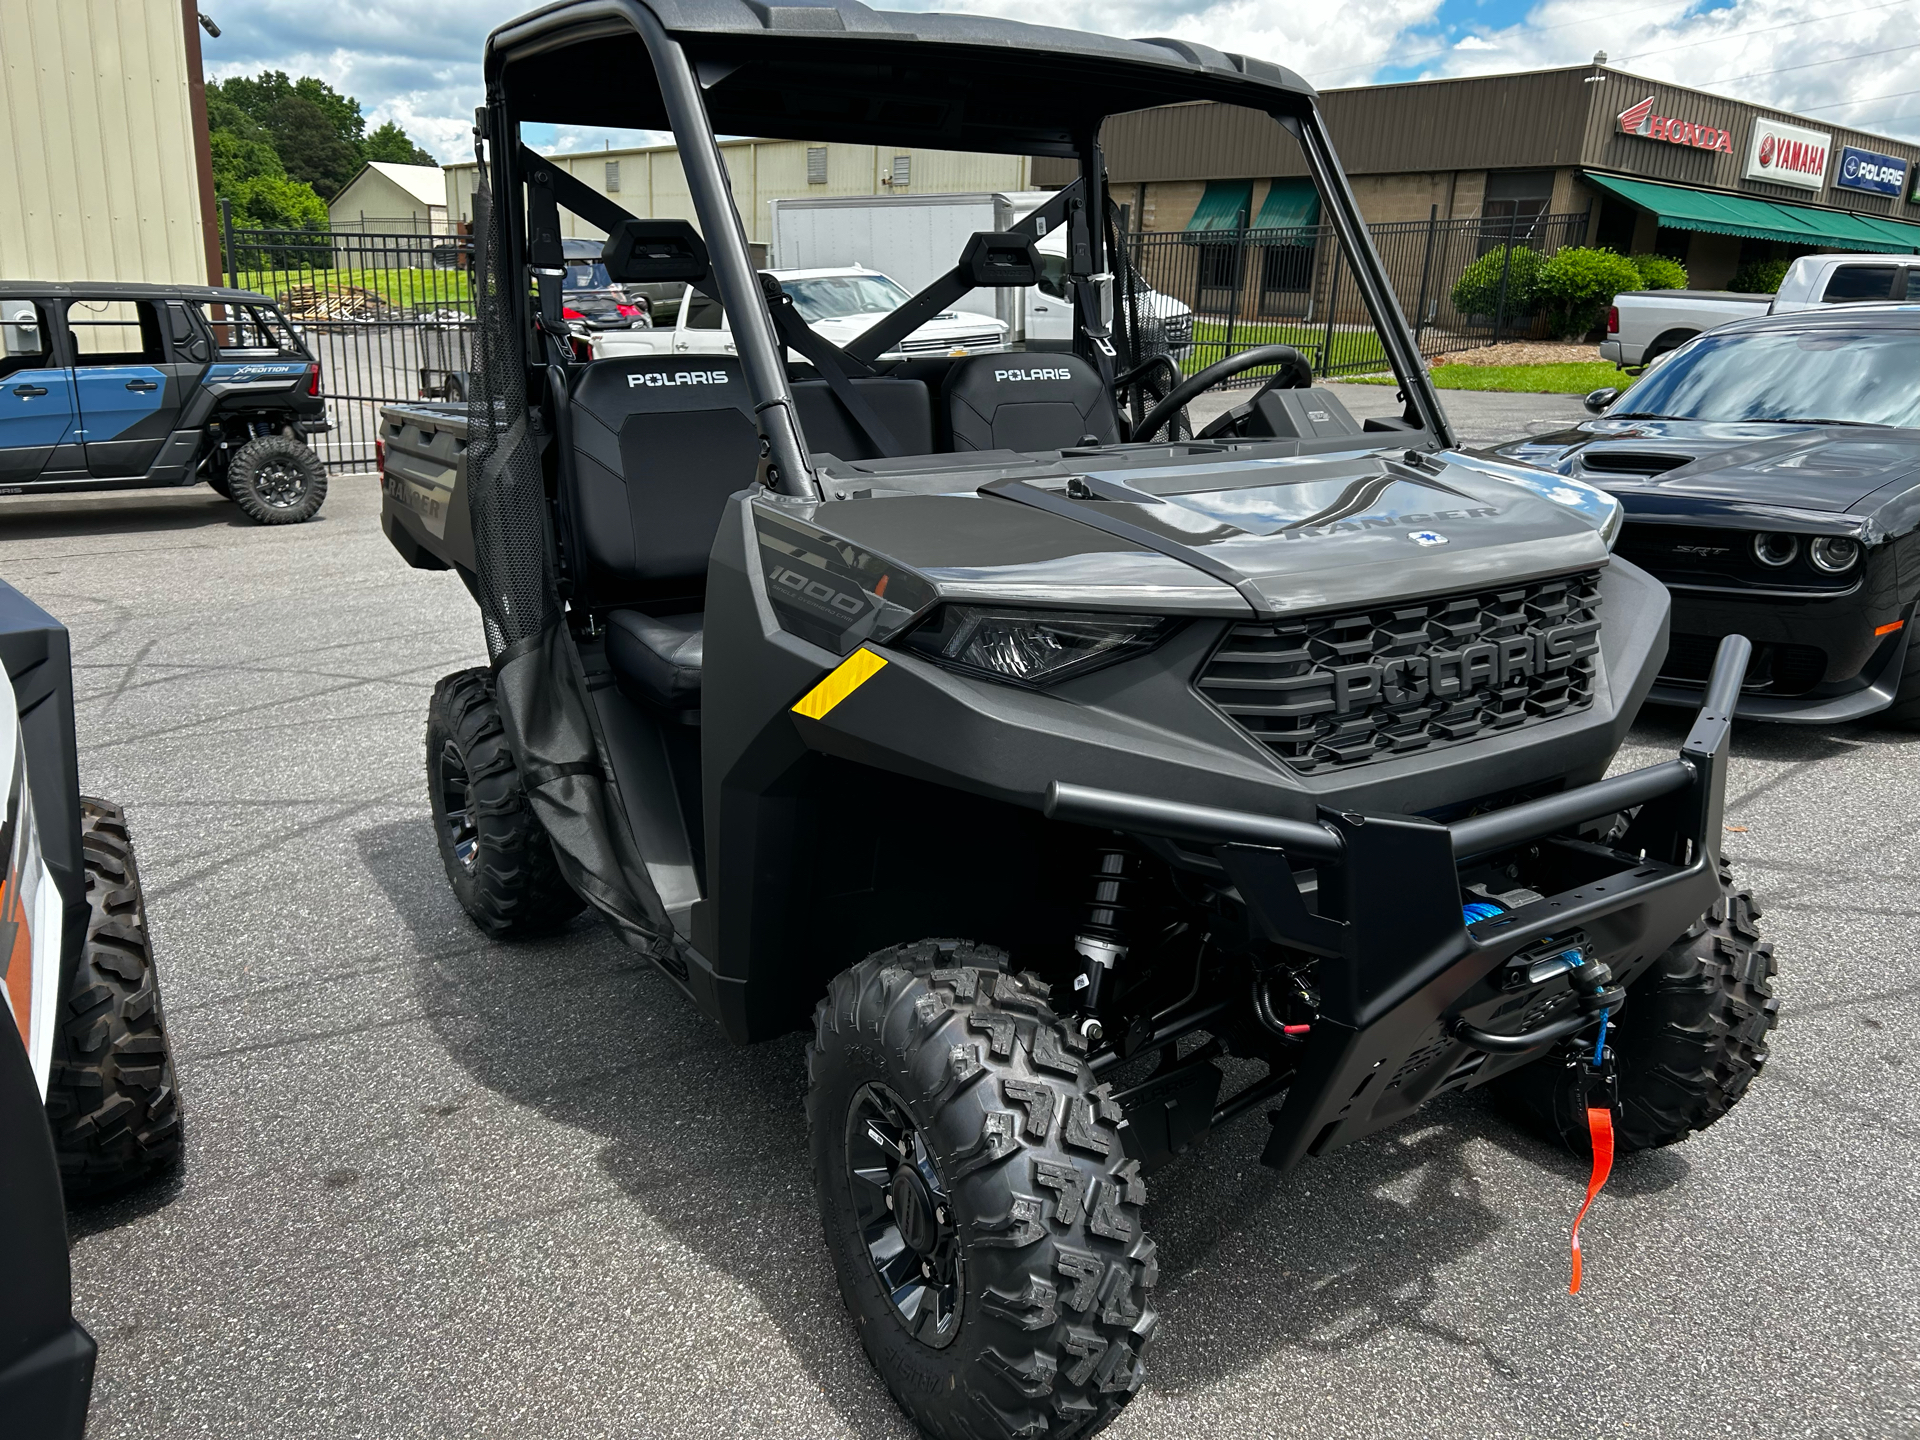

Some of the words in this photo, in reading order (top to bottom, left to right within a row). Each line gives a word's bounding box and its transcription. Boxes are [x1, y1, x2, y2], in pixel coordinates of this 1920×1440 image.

[1647, 114, 1734, 154] HONDA
[1775, 137, 1825, 176] YAMAHA
[1857, 161, 1905, 186] POLARIS
[233, 364, 289, 376] XPEDITION
[627, 370, 729, 388] POLARIS
[994, 368, 1071, 382] POLARIS
[387, 477, 440, 519] RANGER
[1282, 506, 1501, 541] RANGER
[1672, 545, 1730, 557] SRT
[768, 564, 865, 615] 1000
[771, 584, 798, 599] SINGLE
[797, 596, 836, 615] OVERHEAD
[835, 613, 854, 623] CAM
[1333, 624, 1578, 714] POLARIS
